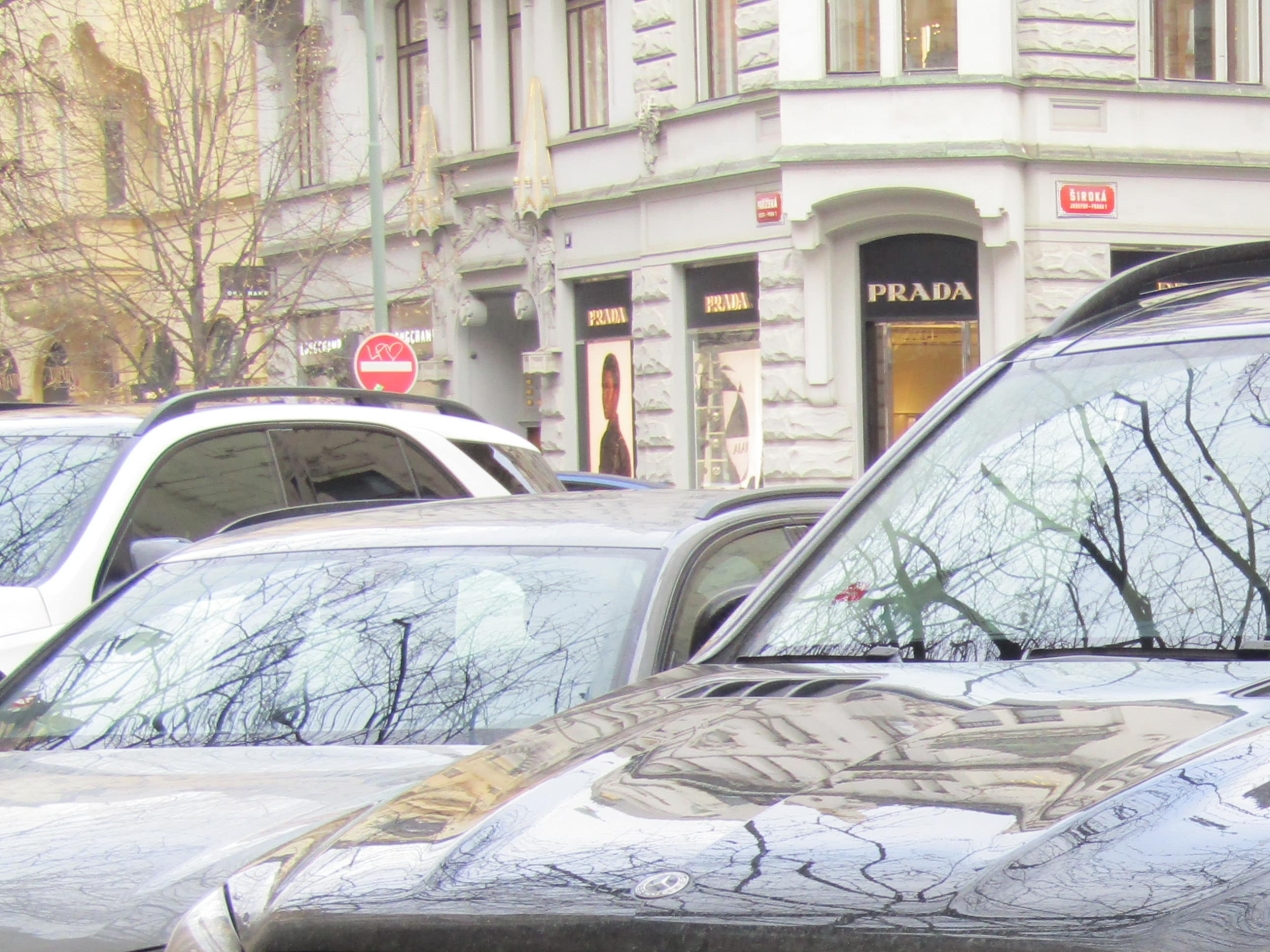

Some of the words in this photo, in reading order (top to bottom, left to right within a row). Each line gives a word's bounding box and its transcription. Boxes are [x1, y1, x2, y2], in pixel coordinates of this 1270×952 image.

[1070, 188, 1107, 202] ŠIROKÁ
[867, 282, 973, 302] PRADA
[705, 291, 752, 314] PRADA
[587, 306, 628, 327] PRADA
